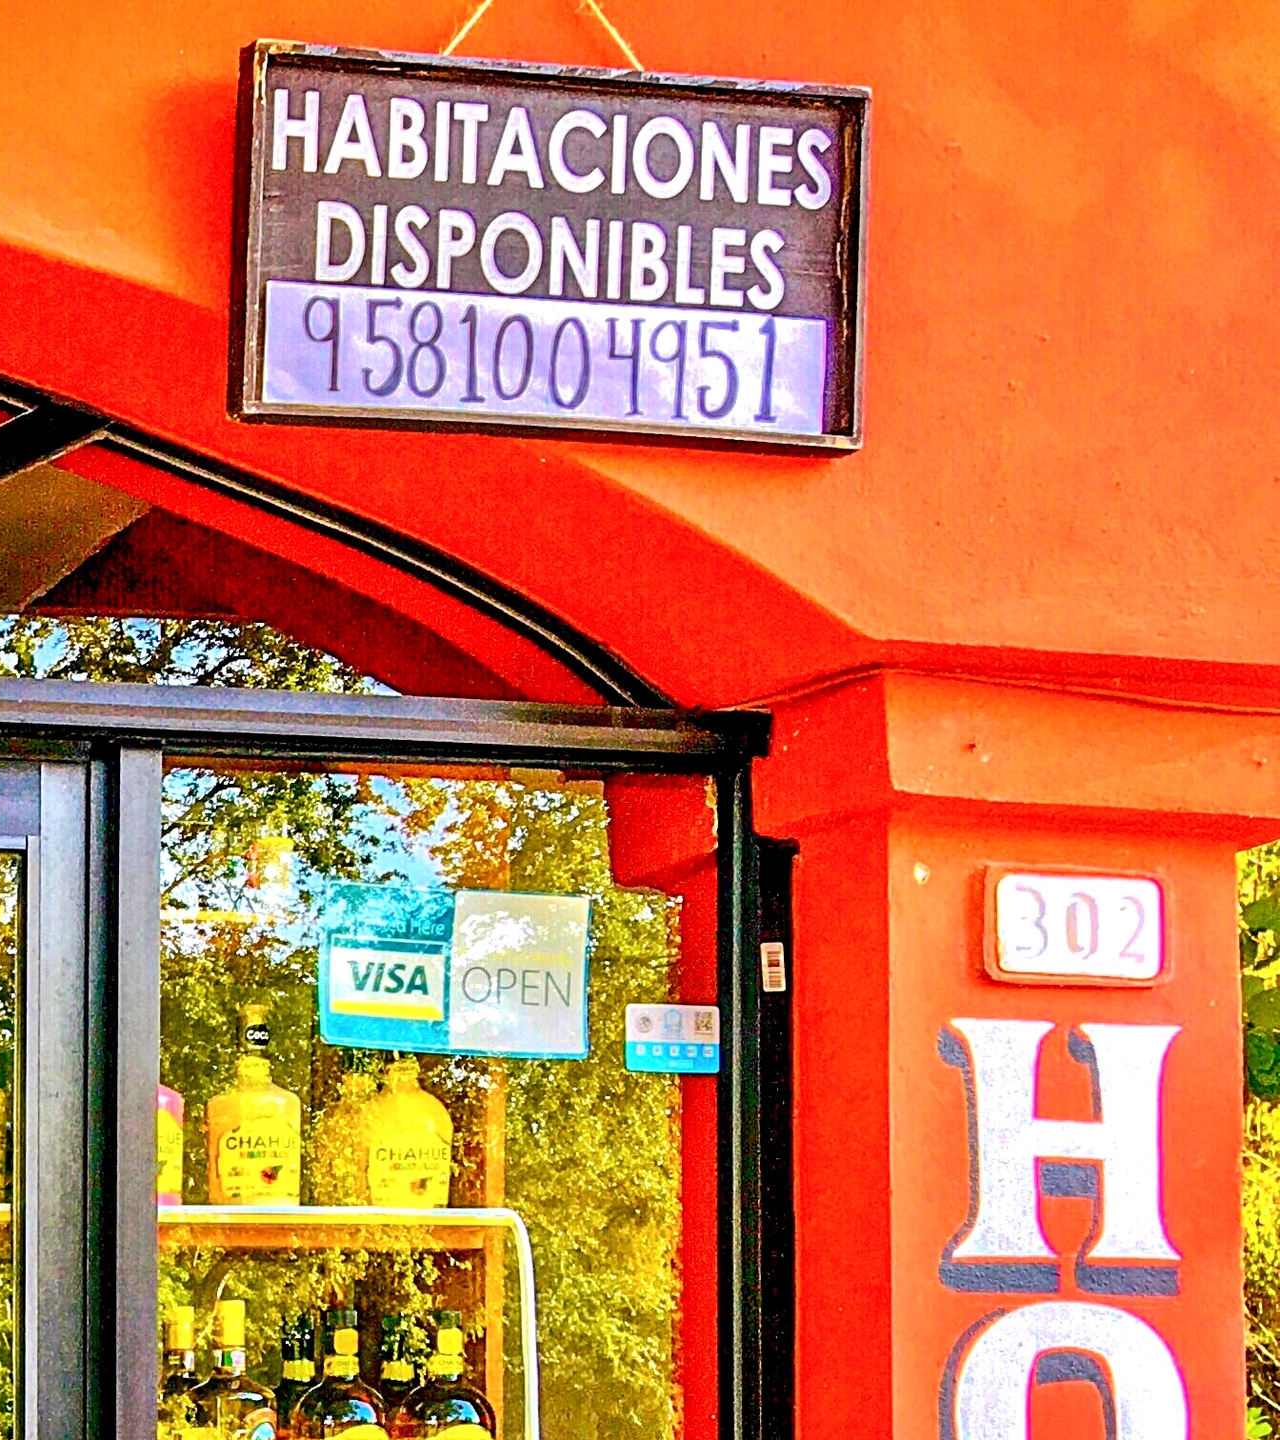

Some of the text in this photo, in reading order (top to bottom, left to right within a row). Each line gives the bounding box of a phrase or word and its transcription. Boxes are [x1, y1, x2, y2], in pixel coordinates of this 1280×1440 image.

[271, 87, 833, 210] HABITACIONES
[314, 200, 787, 310] DISPONIBLES
[1013, 881, 1147, 964] 302
[346, 959, 430, 997] VISA
[461, 965, 572, 1008] OPEN
[225, 1135, 298, 1150] CHAHUE
